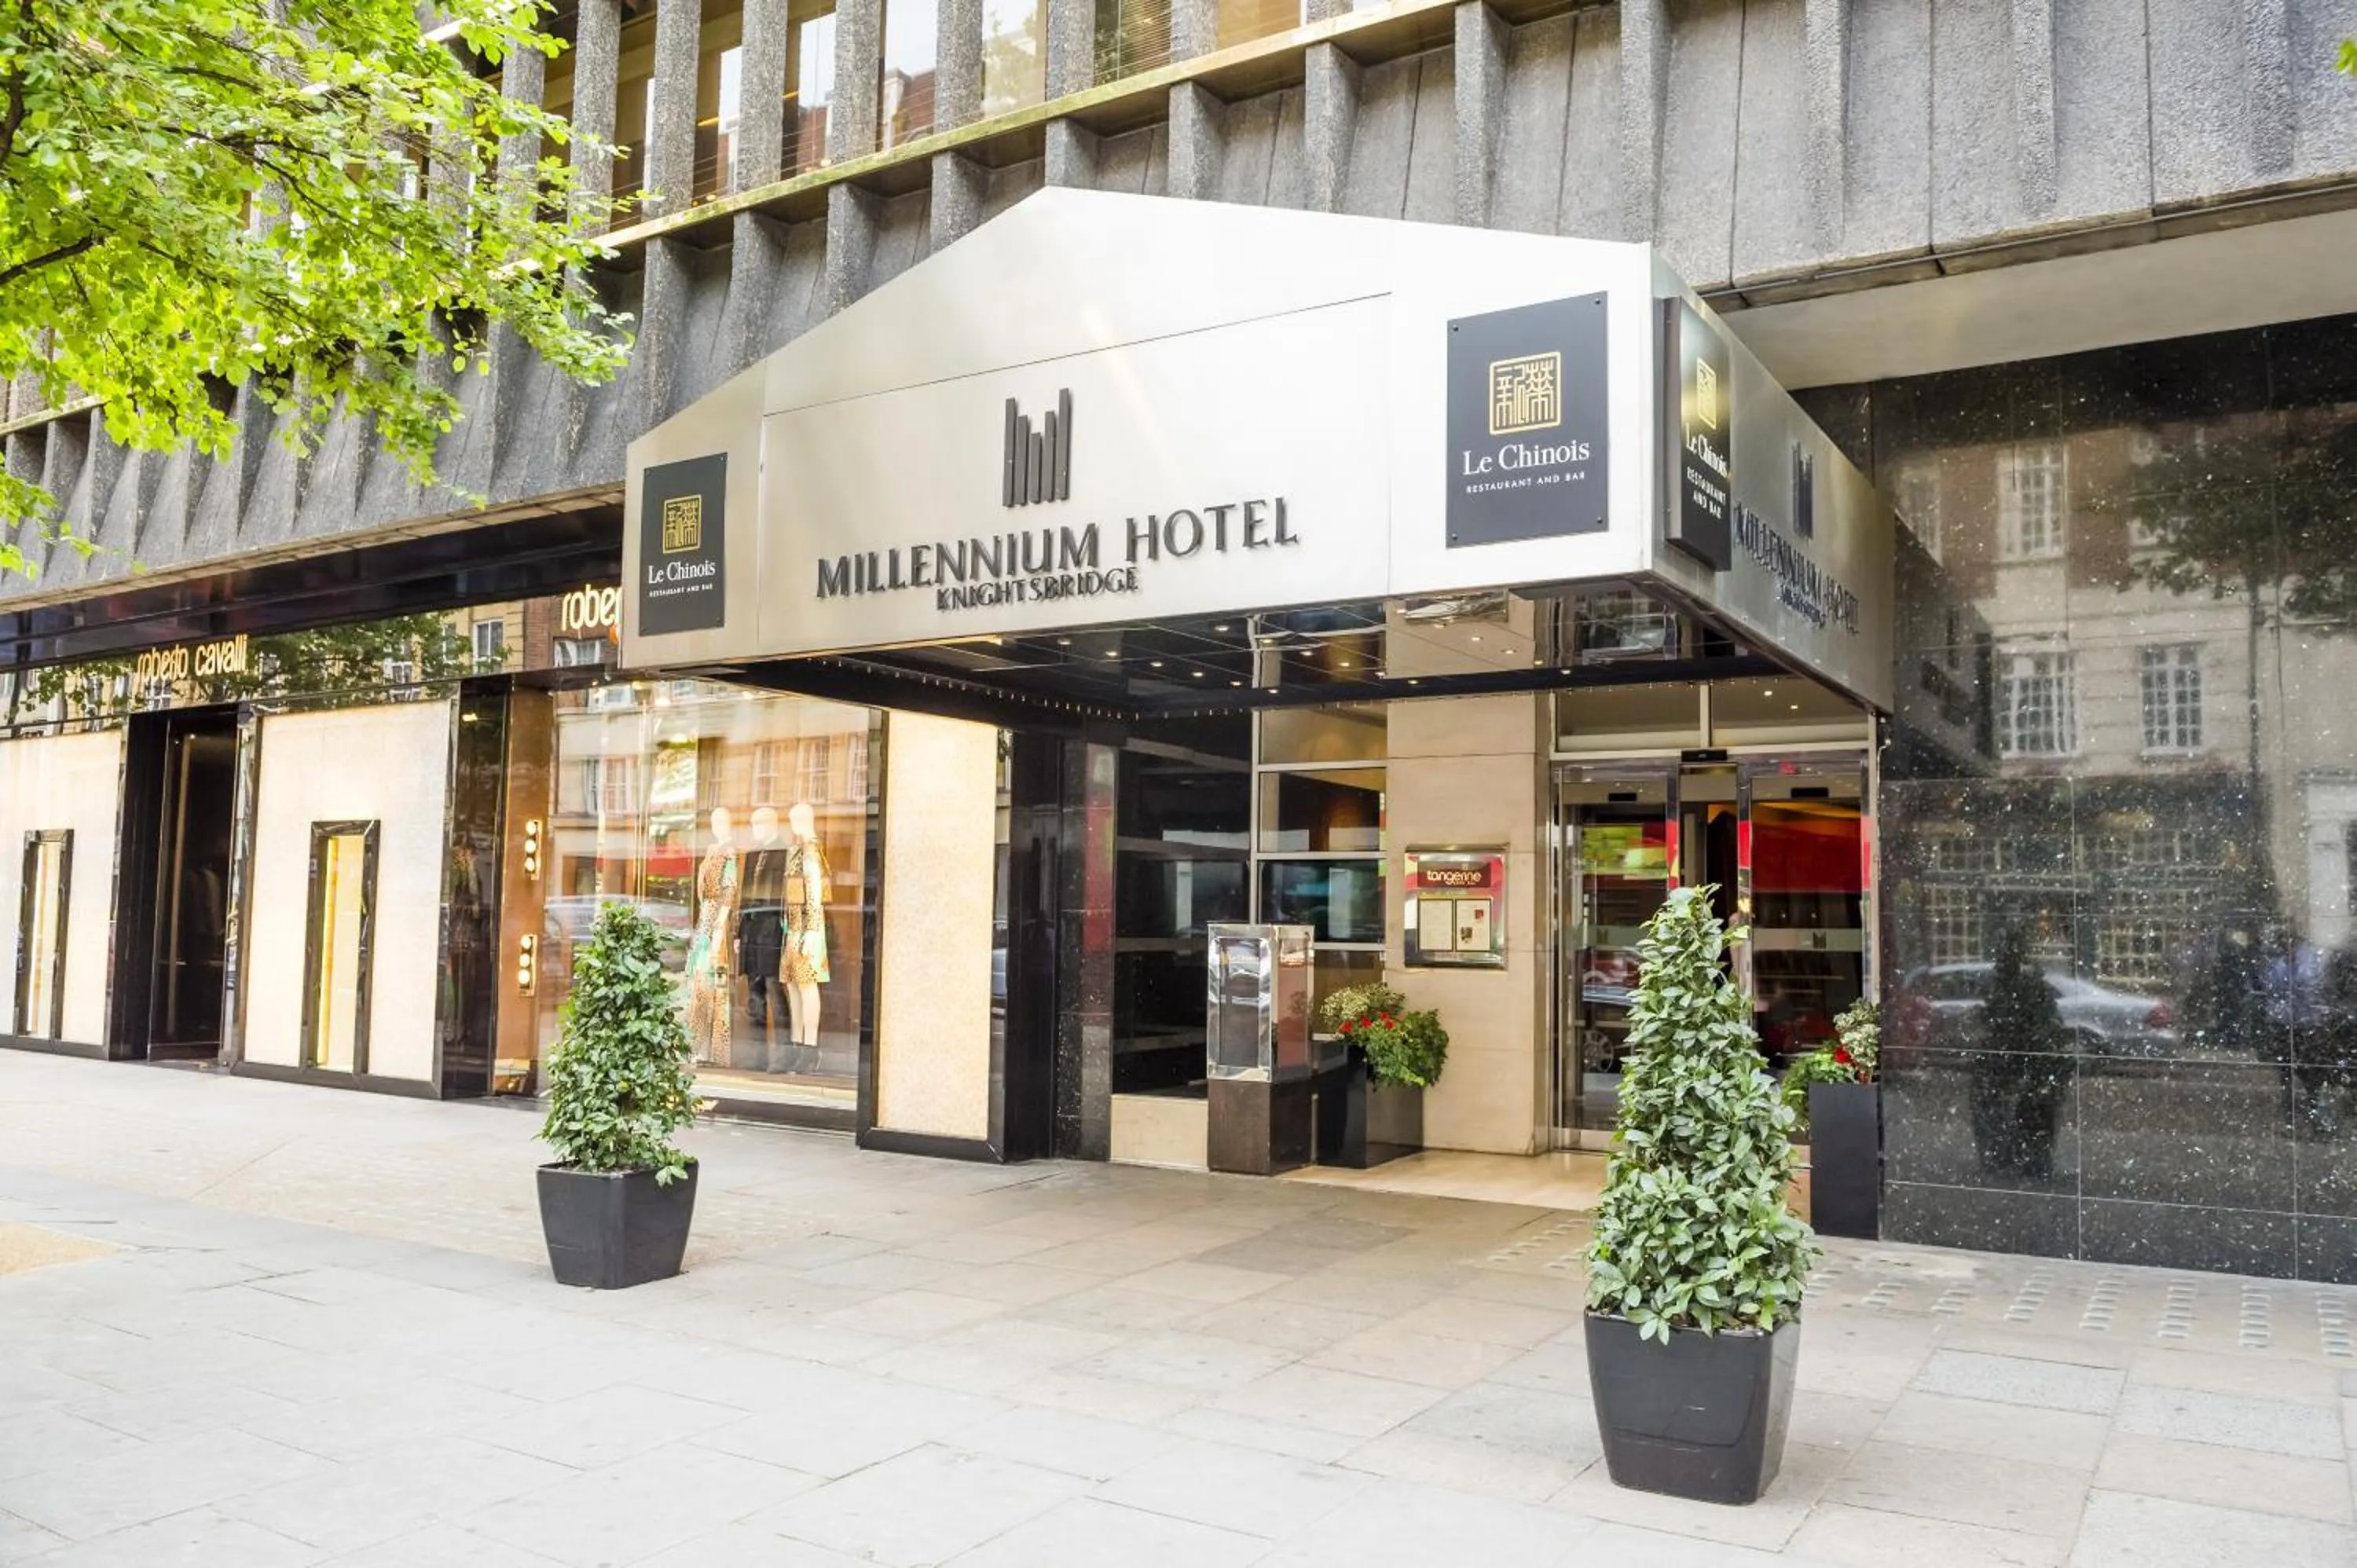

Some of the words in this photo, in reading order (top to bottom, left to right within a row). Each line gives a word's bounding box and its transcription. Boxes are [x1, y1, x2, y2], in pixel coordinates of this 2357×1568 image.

[1463, 450, 1493, 475] Le
[1498, 440, 1590, 471] Chinois
[1686, 422, 1697, 453] Le
[1699, 434, 1728, 478] Chinois
[1466, 478, 1532, 493] RESTAURANT
[1537, 474, 1560, 485] AND
[1565, 471, 1585, 482] BAR
[817, 522, 1100, 598] MILLENNIUM
[1126, 497, 1299, 561] HOTEL
[647, 565, 665, 584] Le
[667, 559, 717, 581] Chinois
[937, 566, 1139, 611] KNIGHTSBRIDGE
[650, 587, 684, 597] RESTAURANT
[196, 633, 248, 676] cavalli
